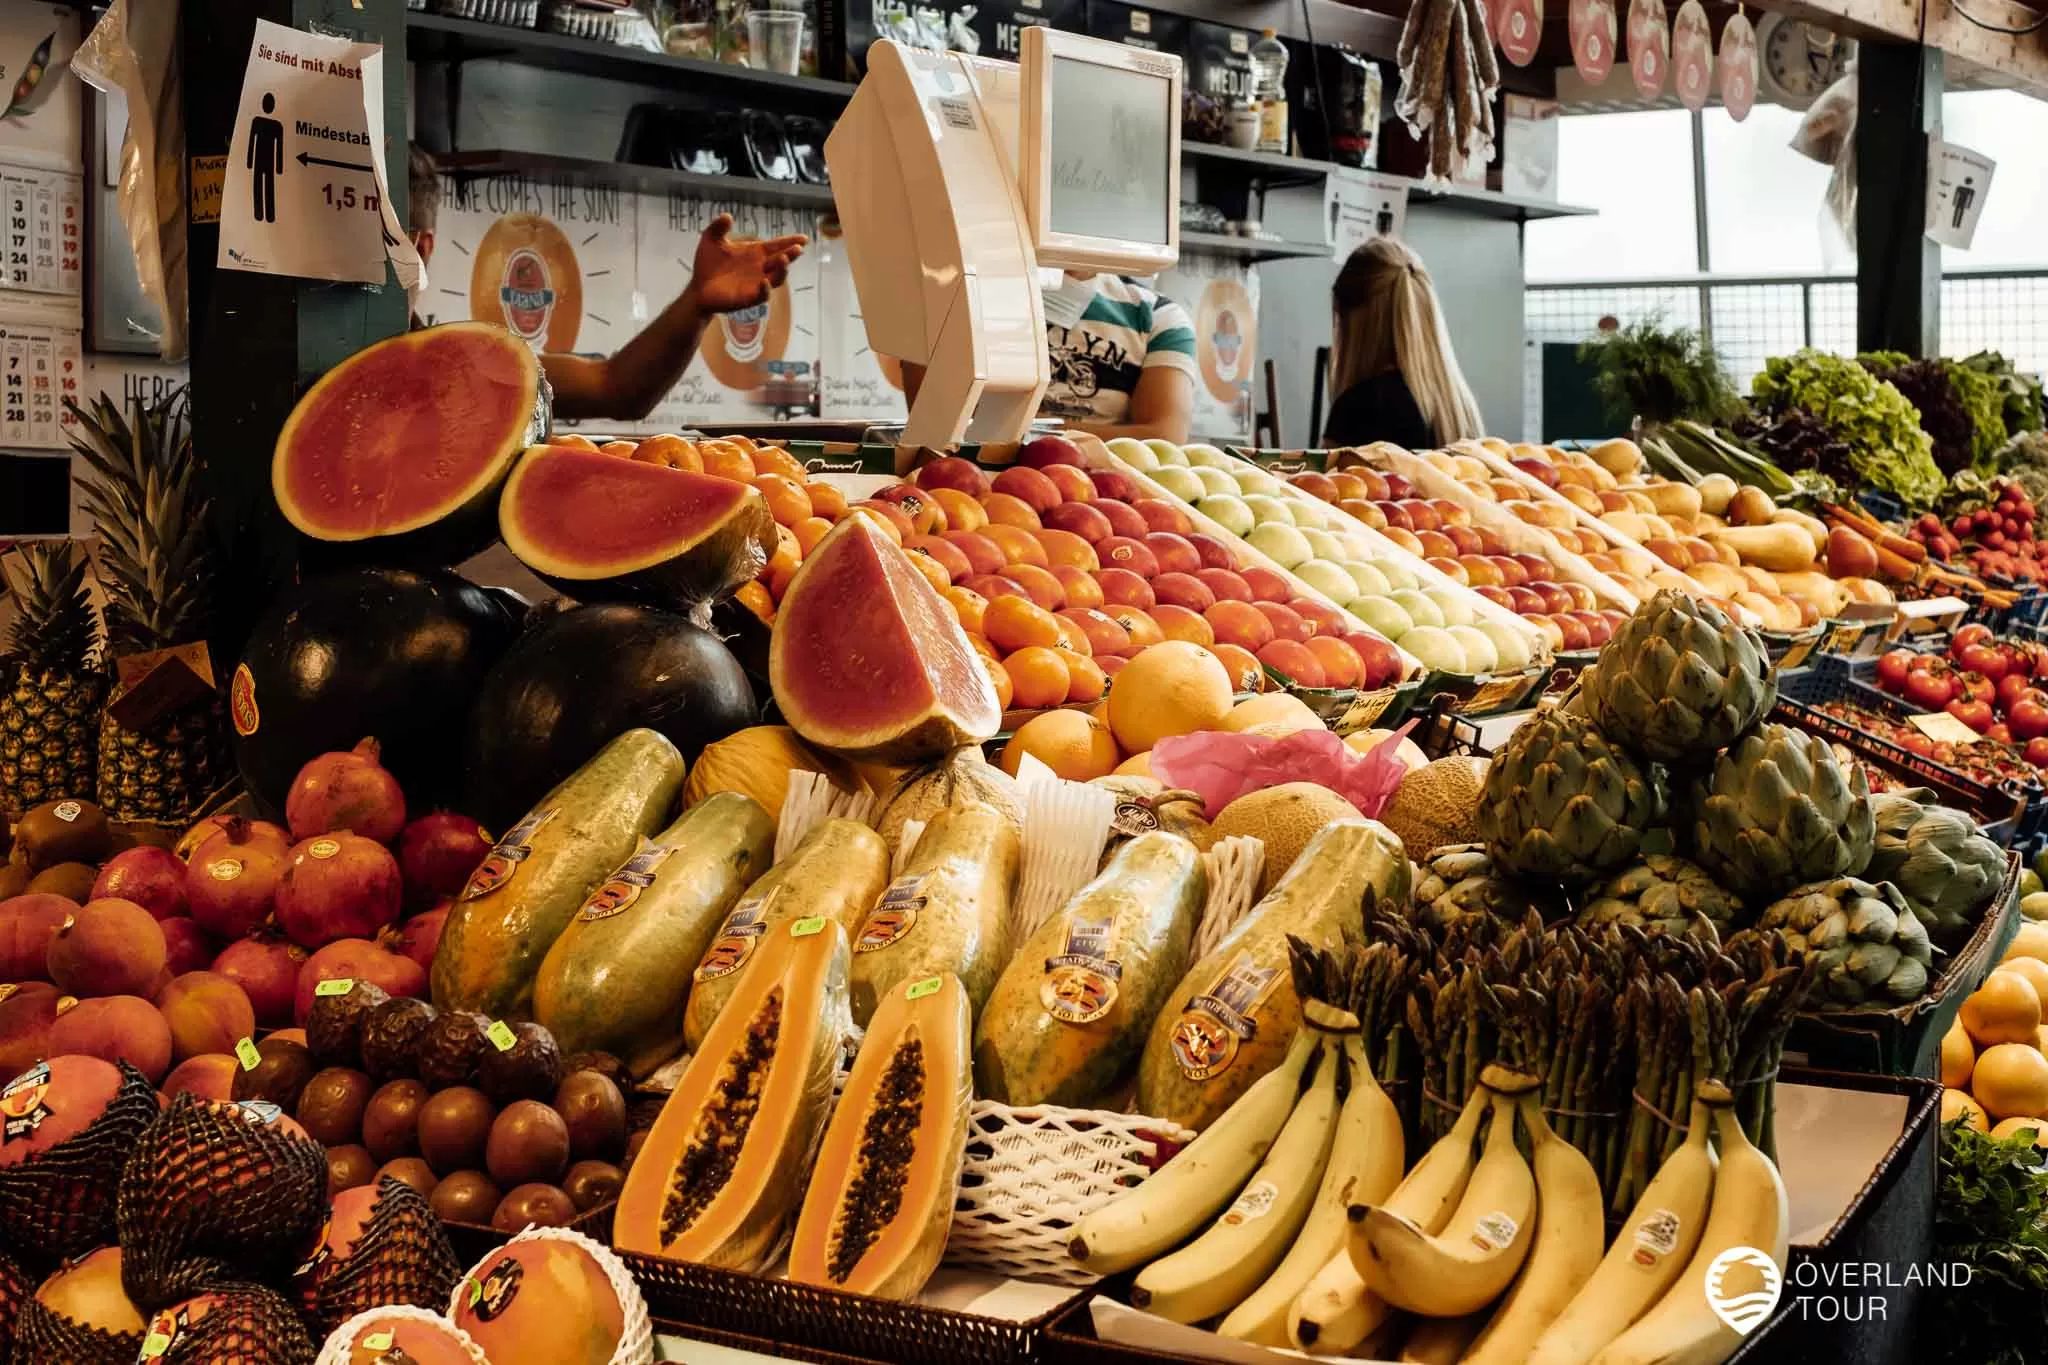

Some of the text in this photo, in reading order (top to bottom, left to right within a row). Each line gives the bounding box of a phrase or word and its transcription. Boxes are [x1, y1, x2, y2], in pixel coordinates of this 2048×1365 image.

[257, 43, 274, 60] Sie
[275, 49, 299, 68] sind
[301, 58, 325, 74] mit
[14, 199, 24, 212] 3
[322, 183, 356, 212] 1,5
[486, 176, 544, 217] COMES
[551, 181, 577, 222] THE
[12, 216, 78, 237] 10 11 12
[12, 233, 26, 248] 17
[63, 240, 78, 255] 19
[11, 251, 79, 271] 24 25 26
[13, 268, 28, 282] 31
[9, 357, 19, 370] 7
[63, 360, 73, 373] 9
[7, 374, 77, 391] 14 15 16
[7, 391, 24, 406] 21
[33, 393, 52, 407] 22
[7, 410, 26, 423] 28
[33, 411, 53, 424] 29
